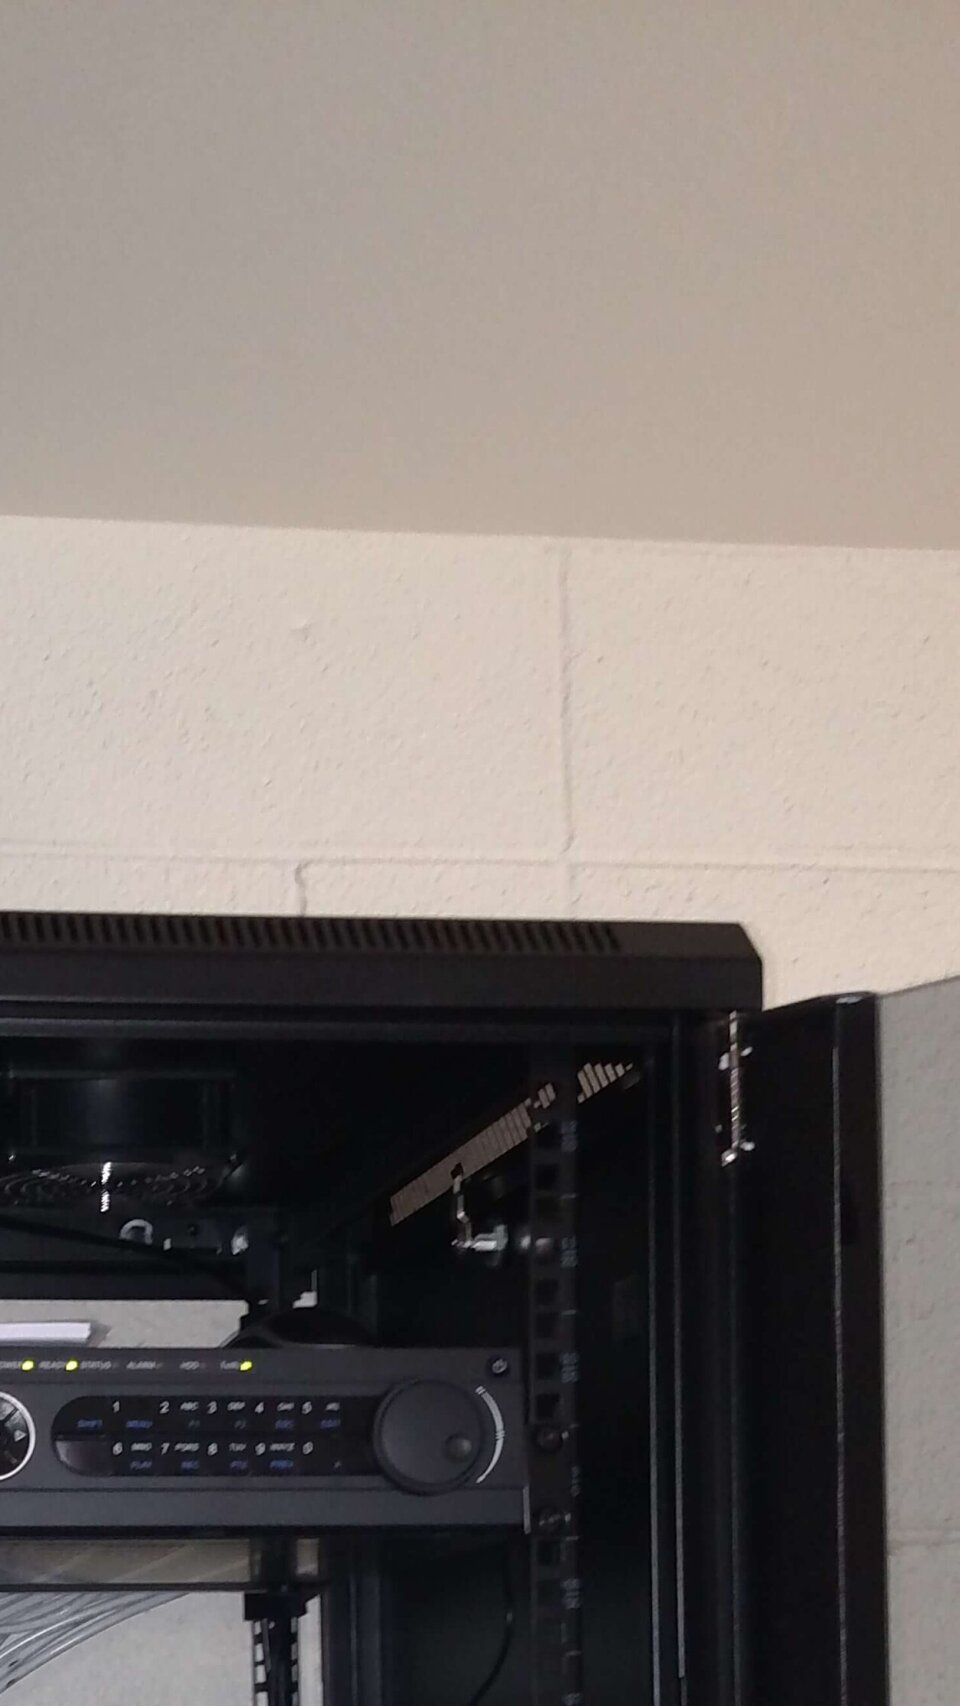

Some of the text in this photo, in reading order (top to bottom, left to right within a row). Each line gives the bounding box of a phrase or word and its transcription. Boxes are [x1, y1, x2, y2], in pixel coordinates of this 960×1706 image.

[160, 1400, 170, 1414] 2
[207, 1401, 218, 1414] 3
[254, 1401, 265, 1414] 4
[161, 1442, 170, 1455] 7
